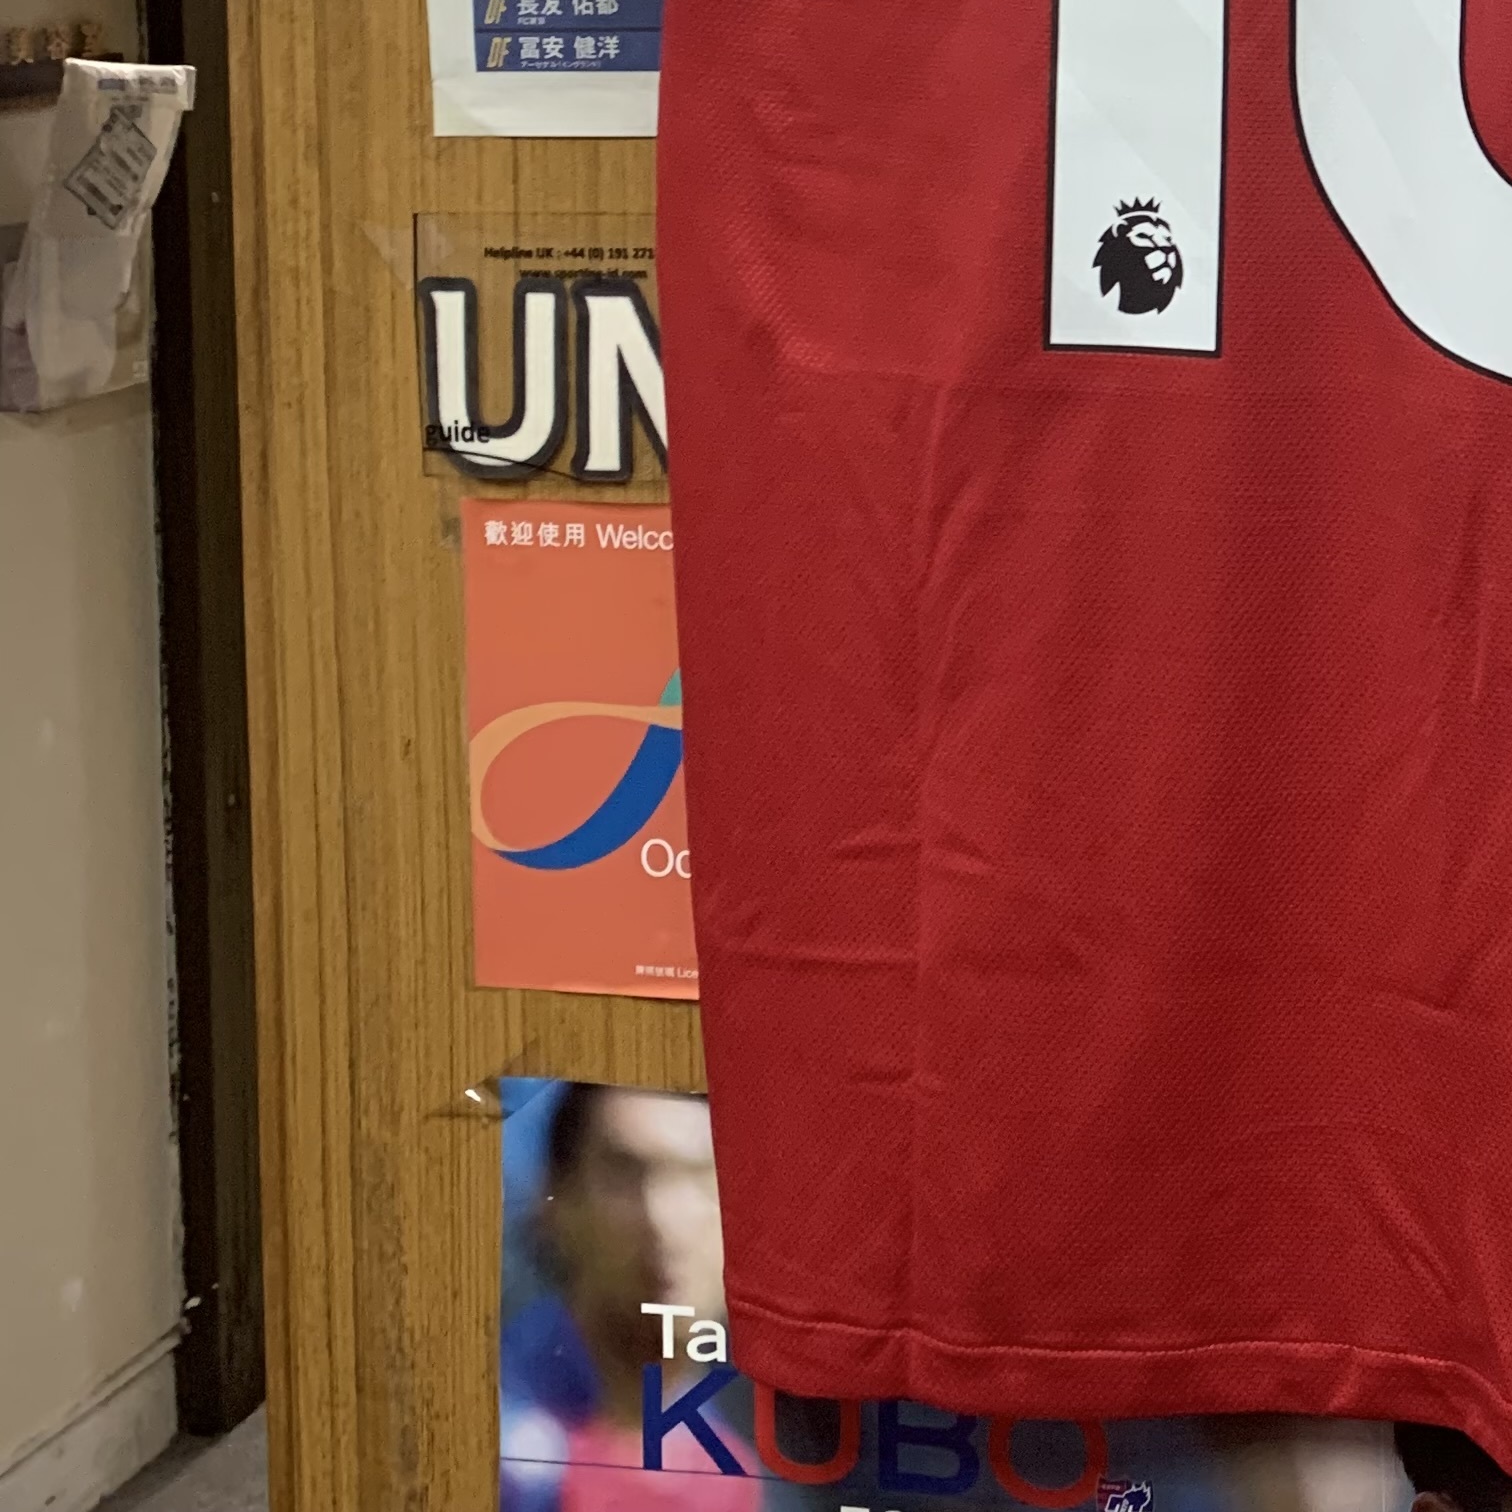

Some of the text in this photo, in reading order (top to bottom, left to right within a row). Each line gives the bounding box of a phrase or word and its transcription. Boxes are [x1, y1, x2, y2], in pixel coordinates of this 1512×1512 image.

[573, 35, 621, 60] 健洋
[484, 246, 534, 261] Helpline
[537, 246, 555, 259] UK
[608, 247, 629, 259] 191
[419, 277, 668, 482] UN
[425, 419, 491, 447] guide
[484, 520, 585, 548] 歡迎使用
[641, 1303, 727, 1362] Ta
[642, 1362, 1108, 1508] KUBO
